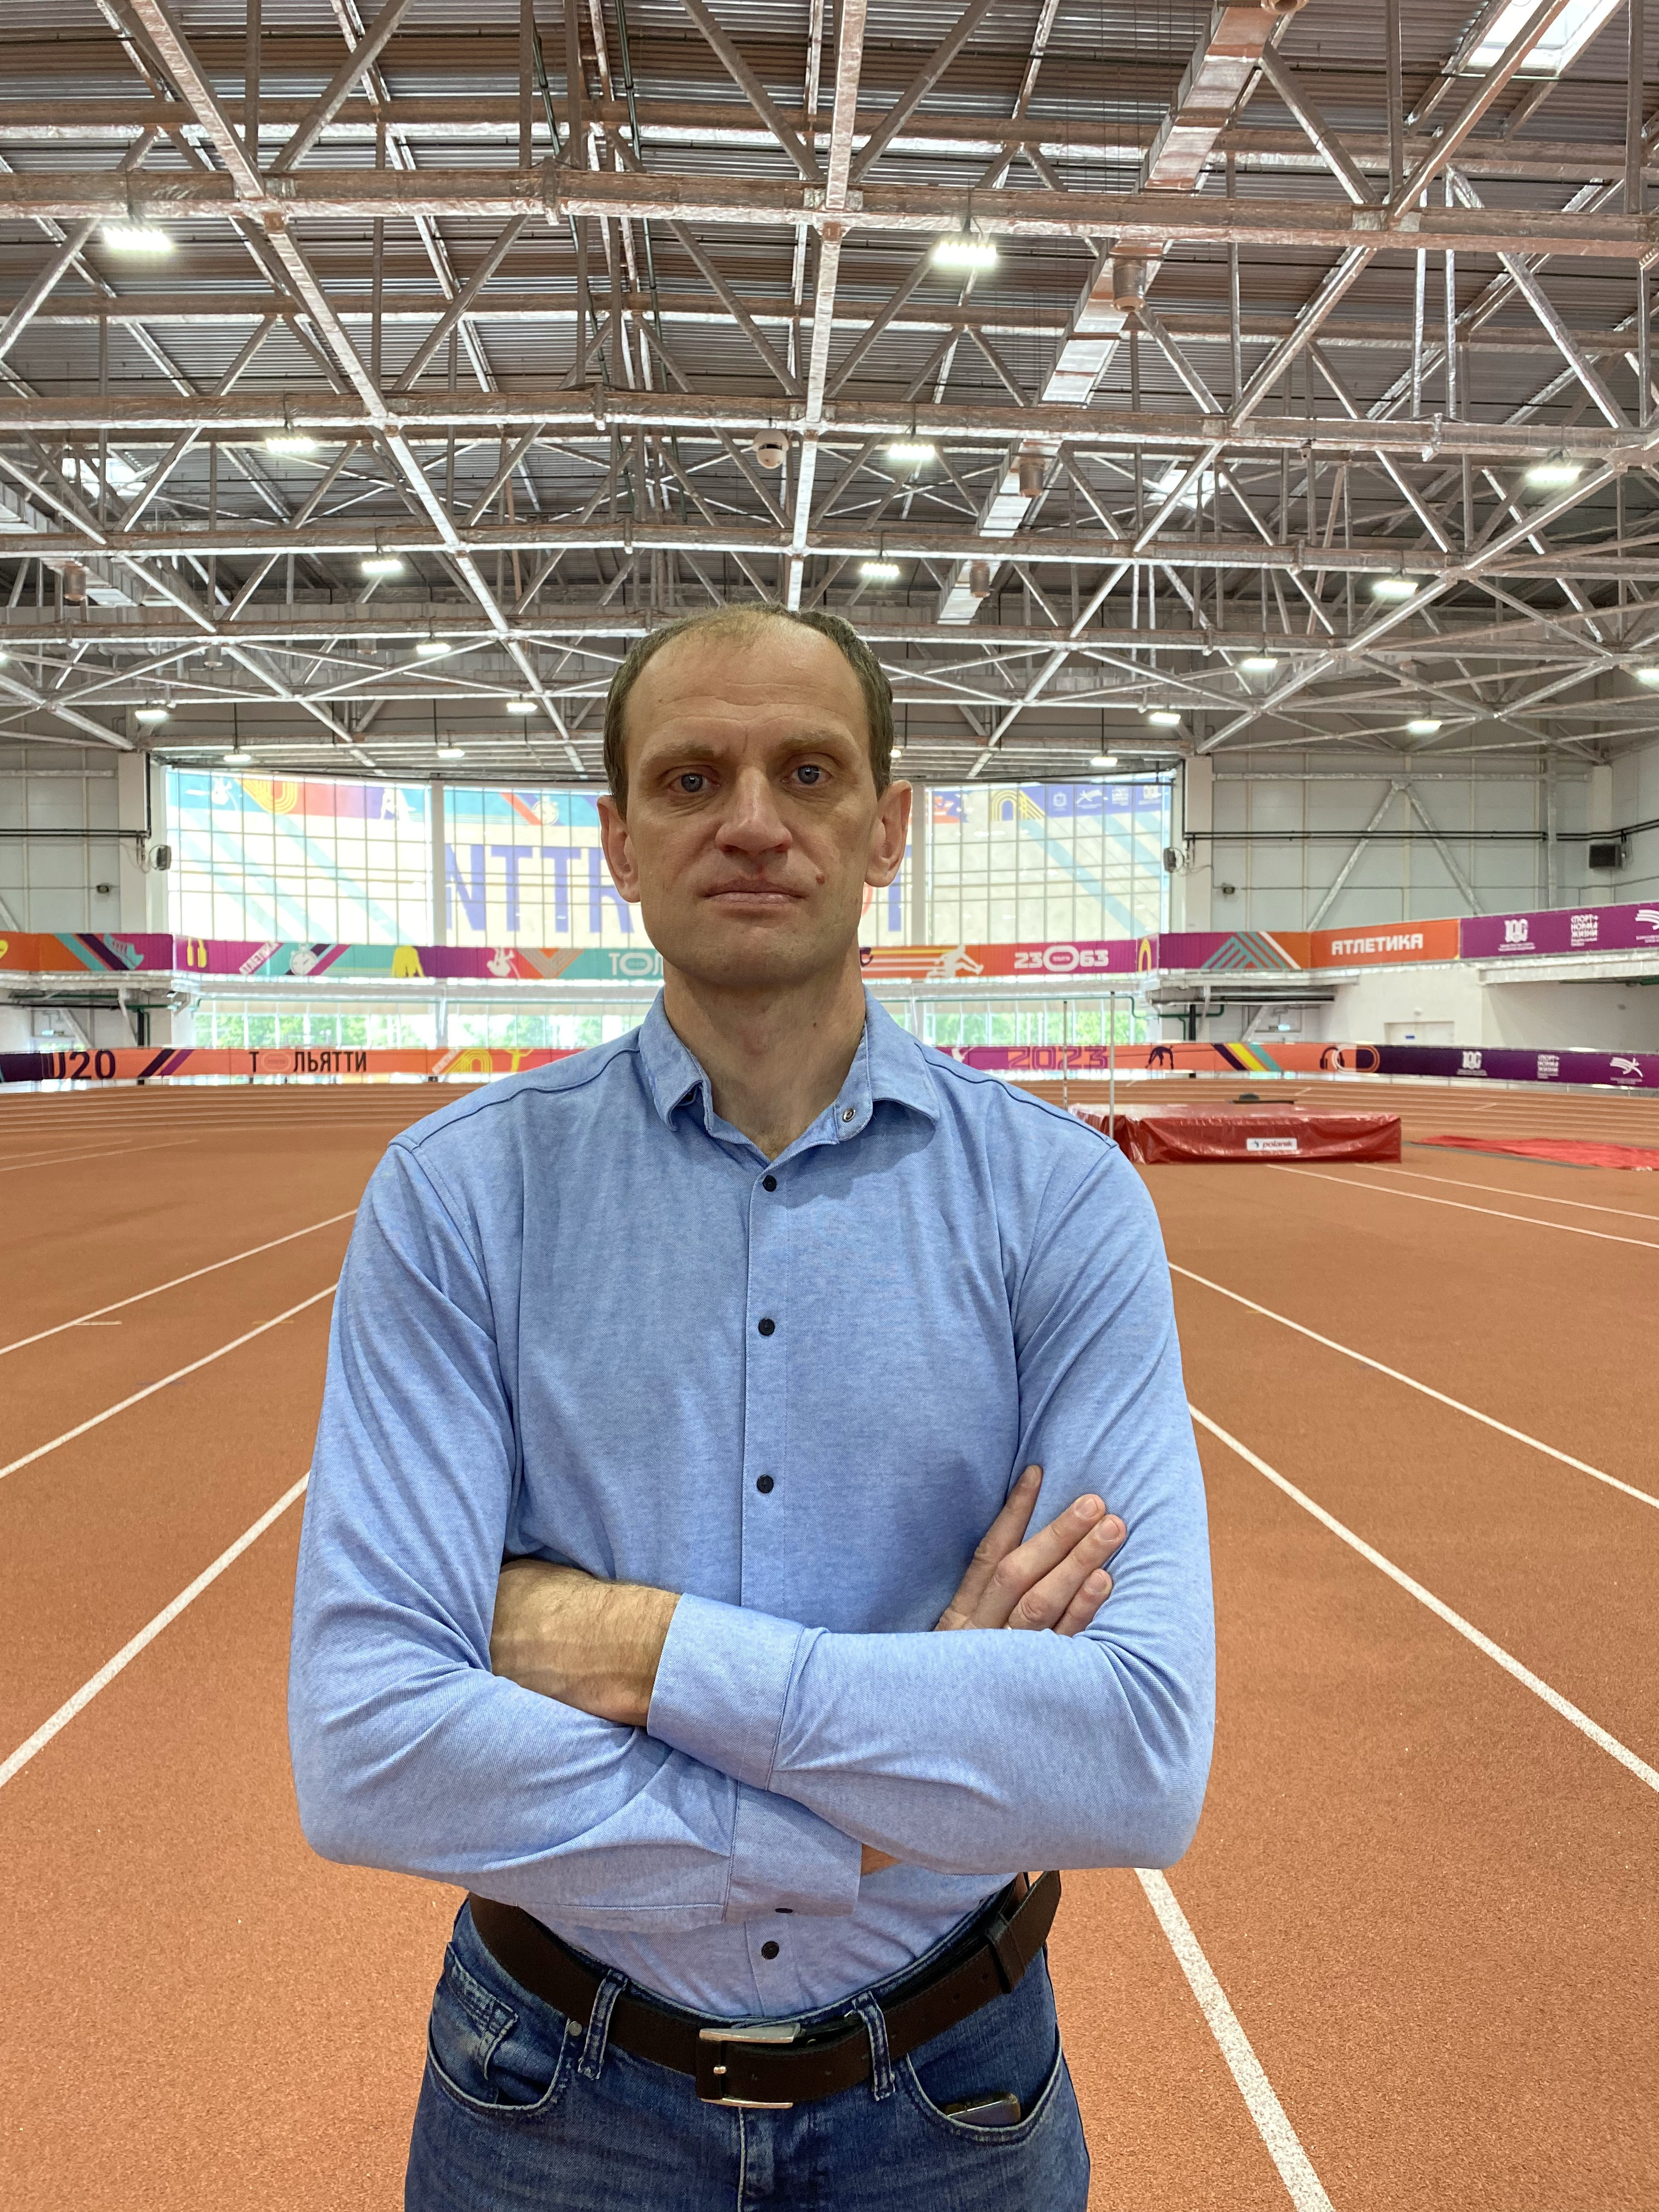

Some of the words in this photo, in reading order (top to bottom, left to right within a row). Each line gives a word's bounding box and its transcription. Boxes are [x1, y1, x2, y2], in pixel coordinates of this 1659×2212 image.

[1331, 933, 1423, 955] АТЛЕТИКА
[42, 1050, 115, 1079] U20
[1008, 1046, 1108, 1070] 2023
